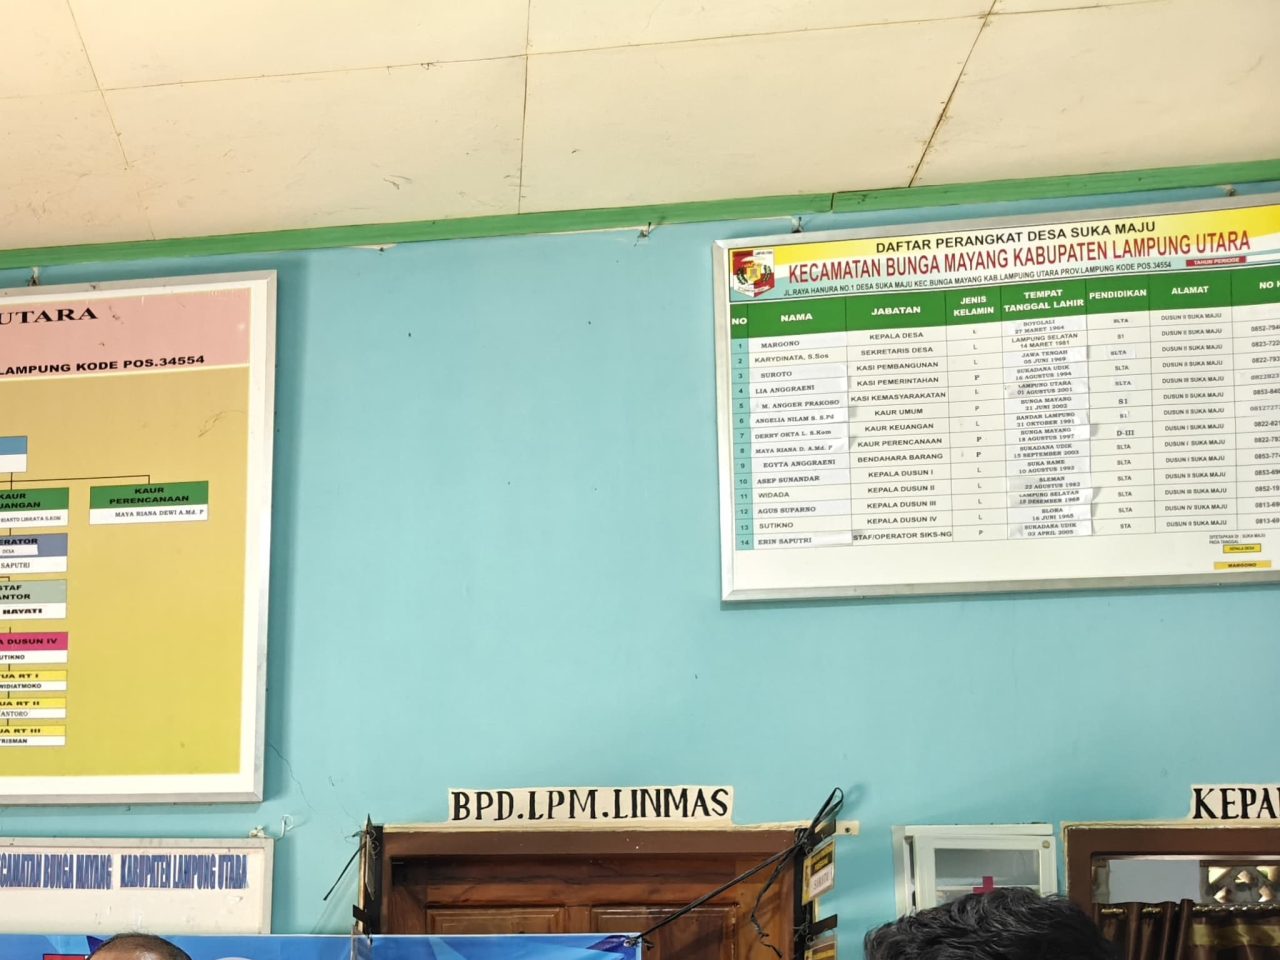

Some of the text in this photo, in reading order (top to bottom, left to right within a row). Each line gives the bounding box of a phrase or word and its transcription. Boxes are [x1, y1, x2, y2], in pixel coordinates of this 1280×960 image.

[877, 222, 1155, 253] DAFTAR PERANGKAT DESA SUKA MAJU
[789, 230, 1250, 283] KECAMATAN BUNGA MAYANG KABUPATEN LAMPUNG UTARA
[784, 287, 810, 296] JL.RAYA
[811, 286, 837, 294] HANURA
[839, 284, 854, 292] NO.1
[856, 283, 873, 291] DESA
[875, 282, 893, 290] SUKA
[914, 279, 952, 287] KEC.BUNGA
[954, 276, 982, 284] MAYANG
[1036, 269, 1059, 277] UTARA
[1061, 264, 1114, 275] PROV.LAMPUNG
[1116, 263, 1136, 271] KODE
[1137, 261, 1171, 270] POS.34554
[1024, 289, 1062, 299] TEMPAT
[1089, 289, 1146, 299] PENDIDIKAN
[1171, 286, 1208, 295] ALAMAT
[960, 296, 986, 304] JENIS
[1004, 299, 1084, 312] TANGGAL LAHIR
[871, 307, 921, 315] JABATAN
[954, 307, 994, 316] KELAMIN
[732, 317, 747, 325] NO
[781, 313, 812, 322] NAMA
[870, 332, 899, 340] KEPALA
[761, 340, 800, 348] MARGONO
[76, 360, 118, 372] KODE
[123, 355, 205, 369] POS.34554
[877, 362, 938, 370] PEMBANGUNAN
[878, 377, 939, 385] PEMERINTAHAN
[110, 496, 189, 504] PERENCANAAN
[853, 532, 917, 541] STAF/OPERATOR
[451, 788, 729, 820] BPD.LPM.LINMAS
[1192, 788, 1280, 819] KEPA
[43, 854, 73, 889] BUNGA
[75, 854, 112, 889] MAYANG
[120, 855, 171, 888] KABUPATEN
[173, 854, 216, 890] LAMPUNG
[218, 855, 248, 890] UTARA
